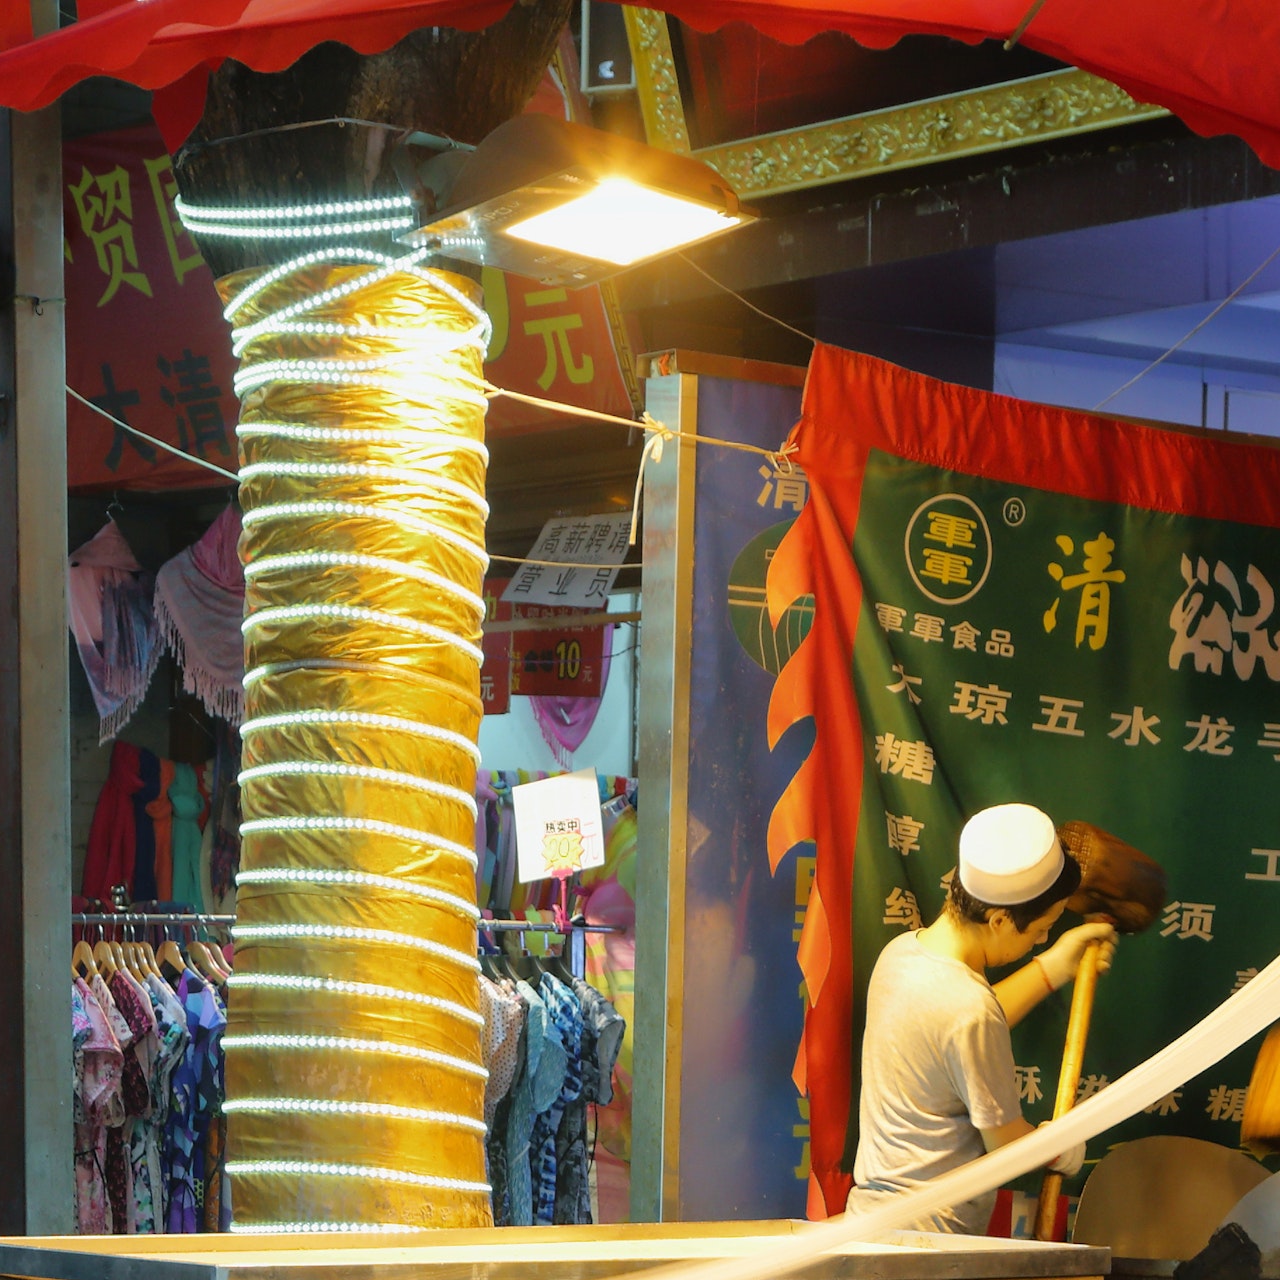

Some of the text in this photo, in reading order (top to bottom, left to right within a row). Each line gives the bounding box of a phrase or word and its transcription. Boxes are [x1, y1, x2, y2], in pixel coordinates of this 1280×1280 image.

[514, 564, 612, 598] 营业员
[920, 511, 978, 586] 軍軍
[1042, 531, 1127, 651] 清
[875, 602, 1014, 658] 軍軍食品
